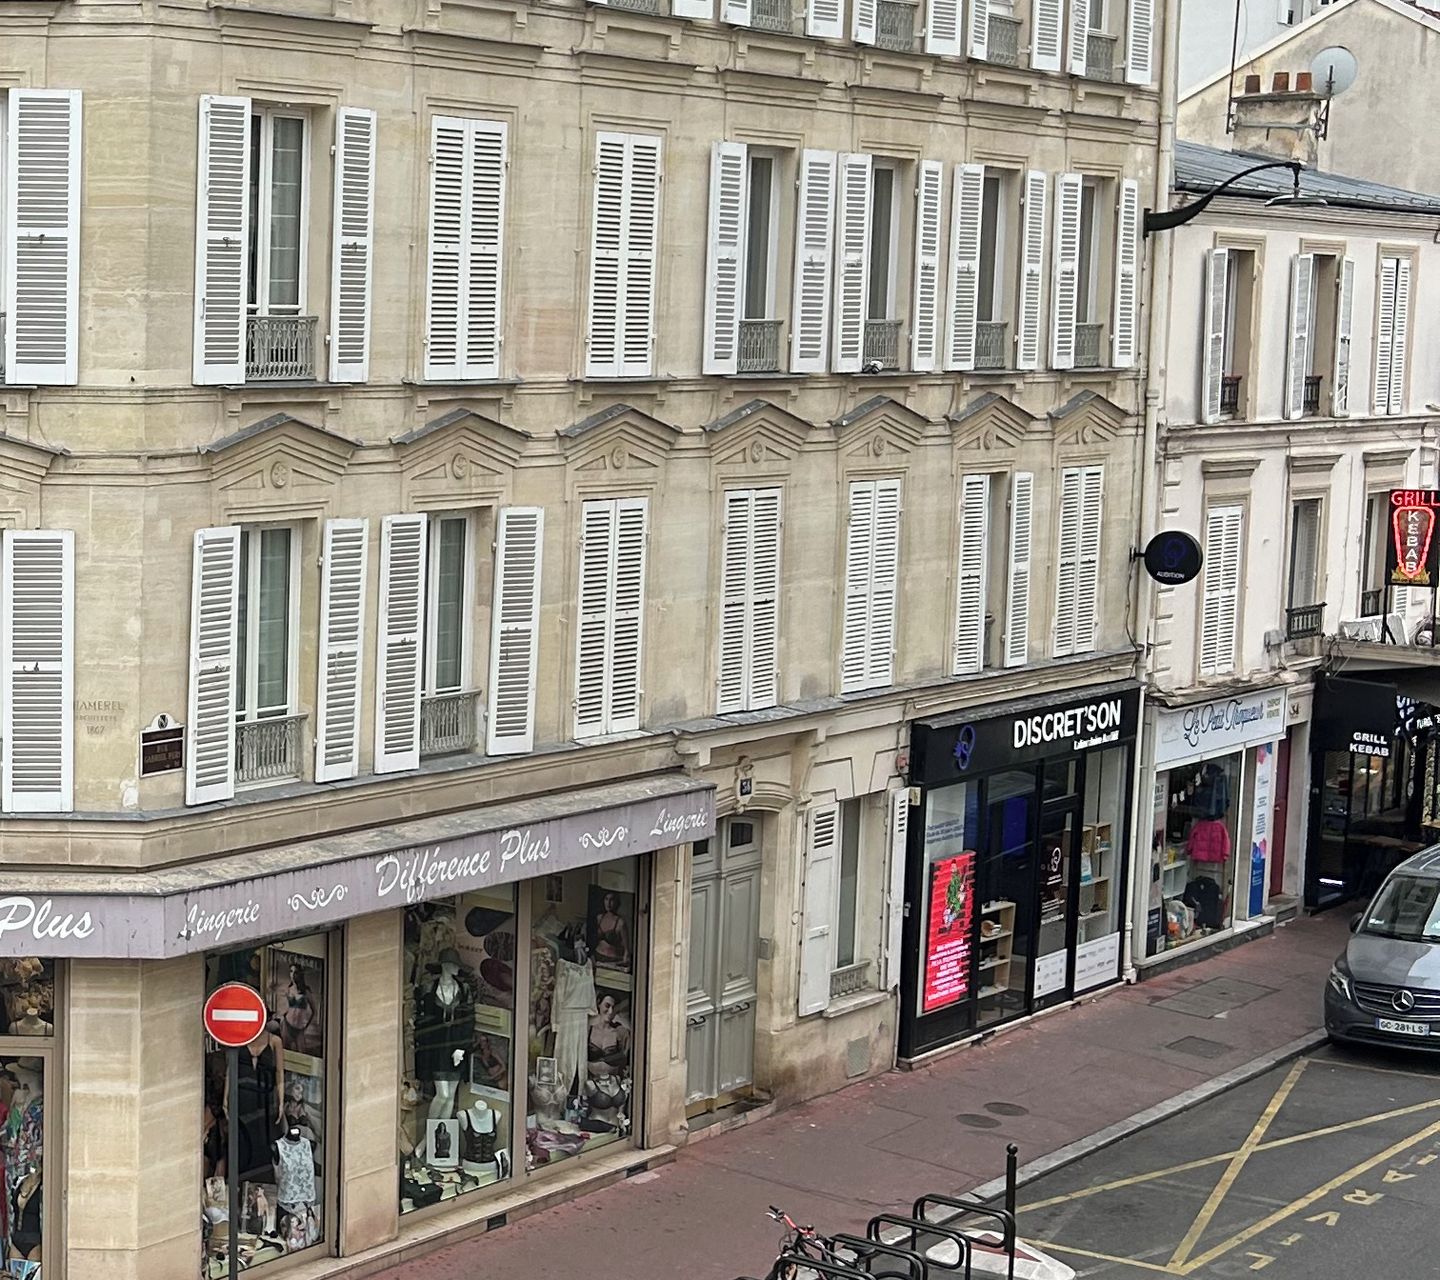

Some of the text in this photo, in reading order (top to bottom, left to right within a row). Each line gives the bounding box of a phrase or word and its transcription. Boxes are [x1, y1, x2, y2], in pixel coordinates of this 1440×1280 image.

[1391, 491, 1440, 507] GRILL
[1405, 510, 1420, 572] KEBAB
[1013, 699, 1122, 749] DISCRET'SON
[1349, 742, 1390, 756] KEBAB
[1352, 732, 1388, 745] GRILL
[179, 807, 709, 941] Lingerie Différence Plus Lingerie
[1245, 1141, 1440, 1271] LIVRAI
